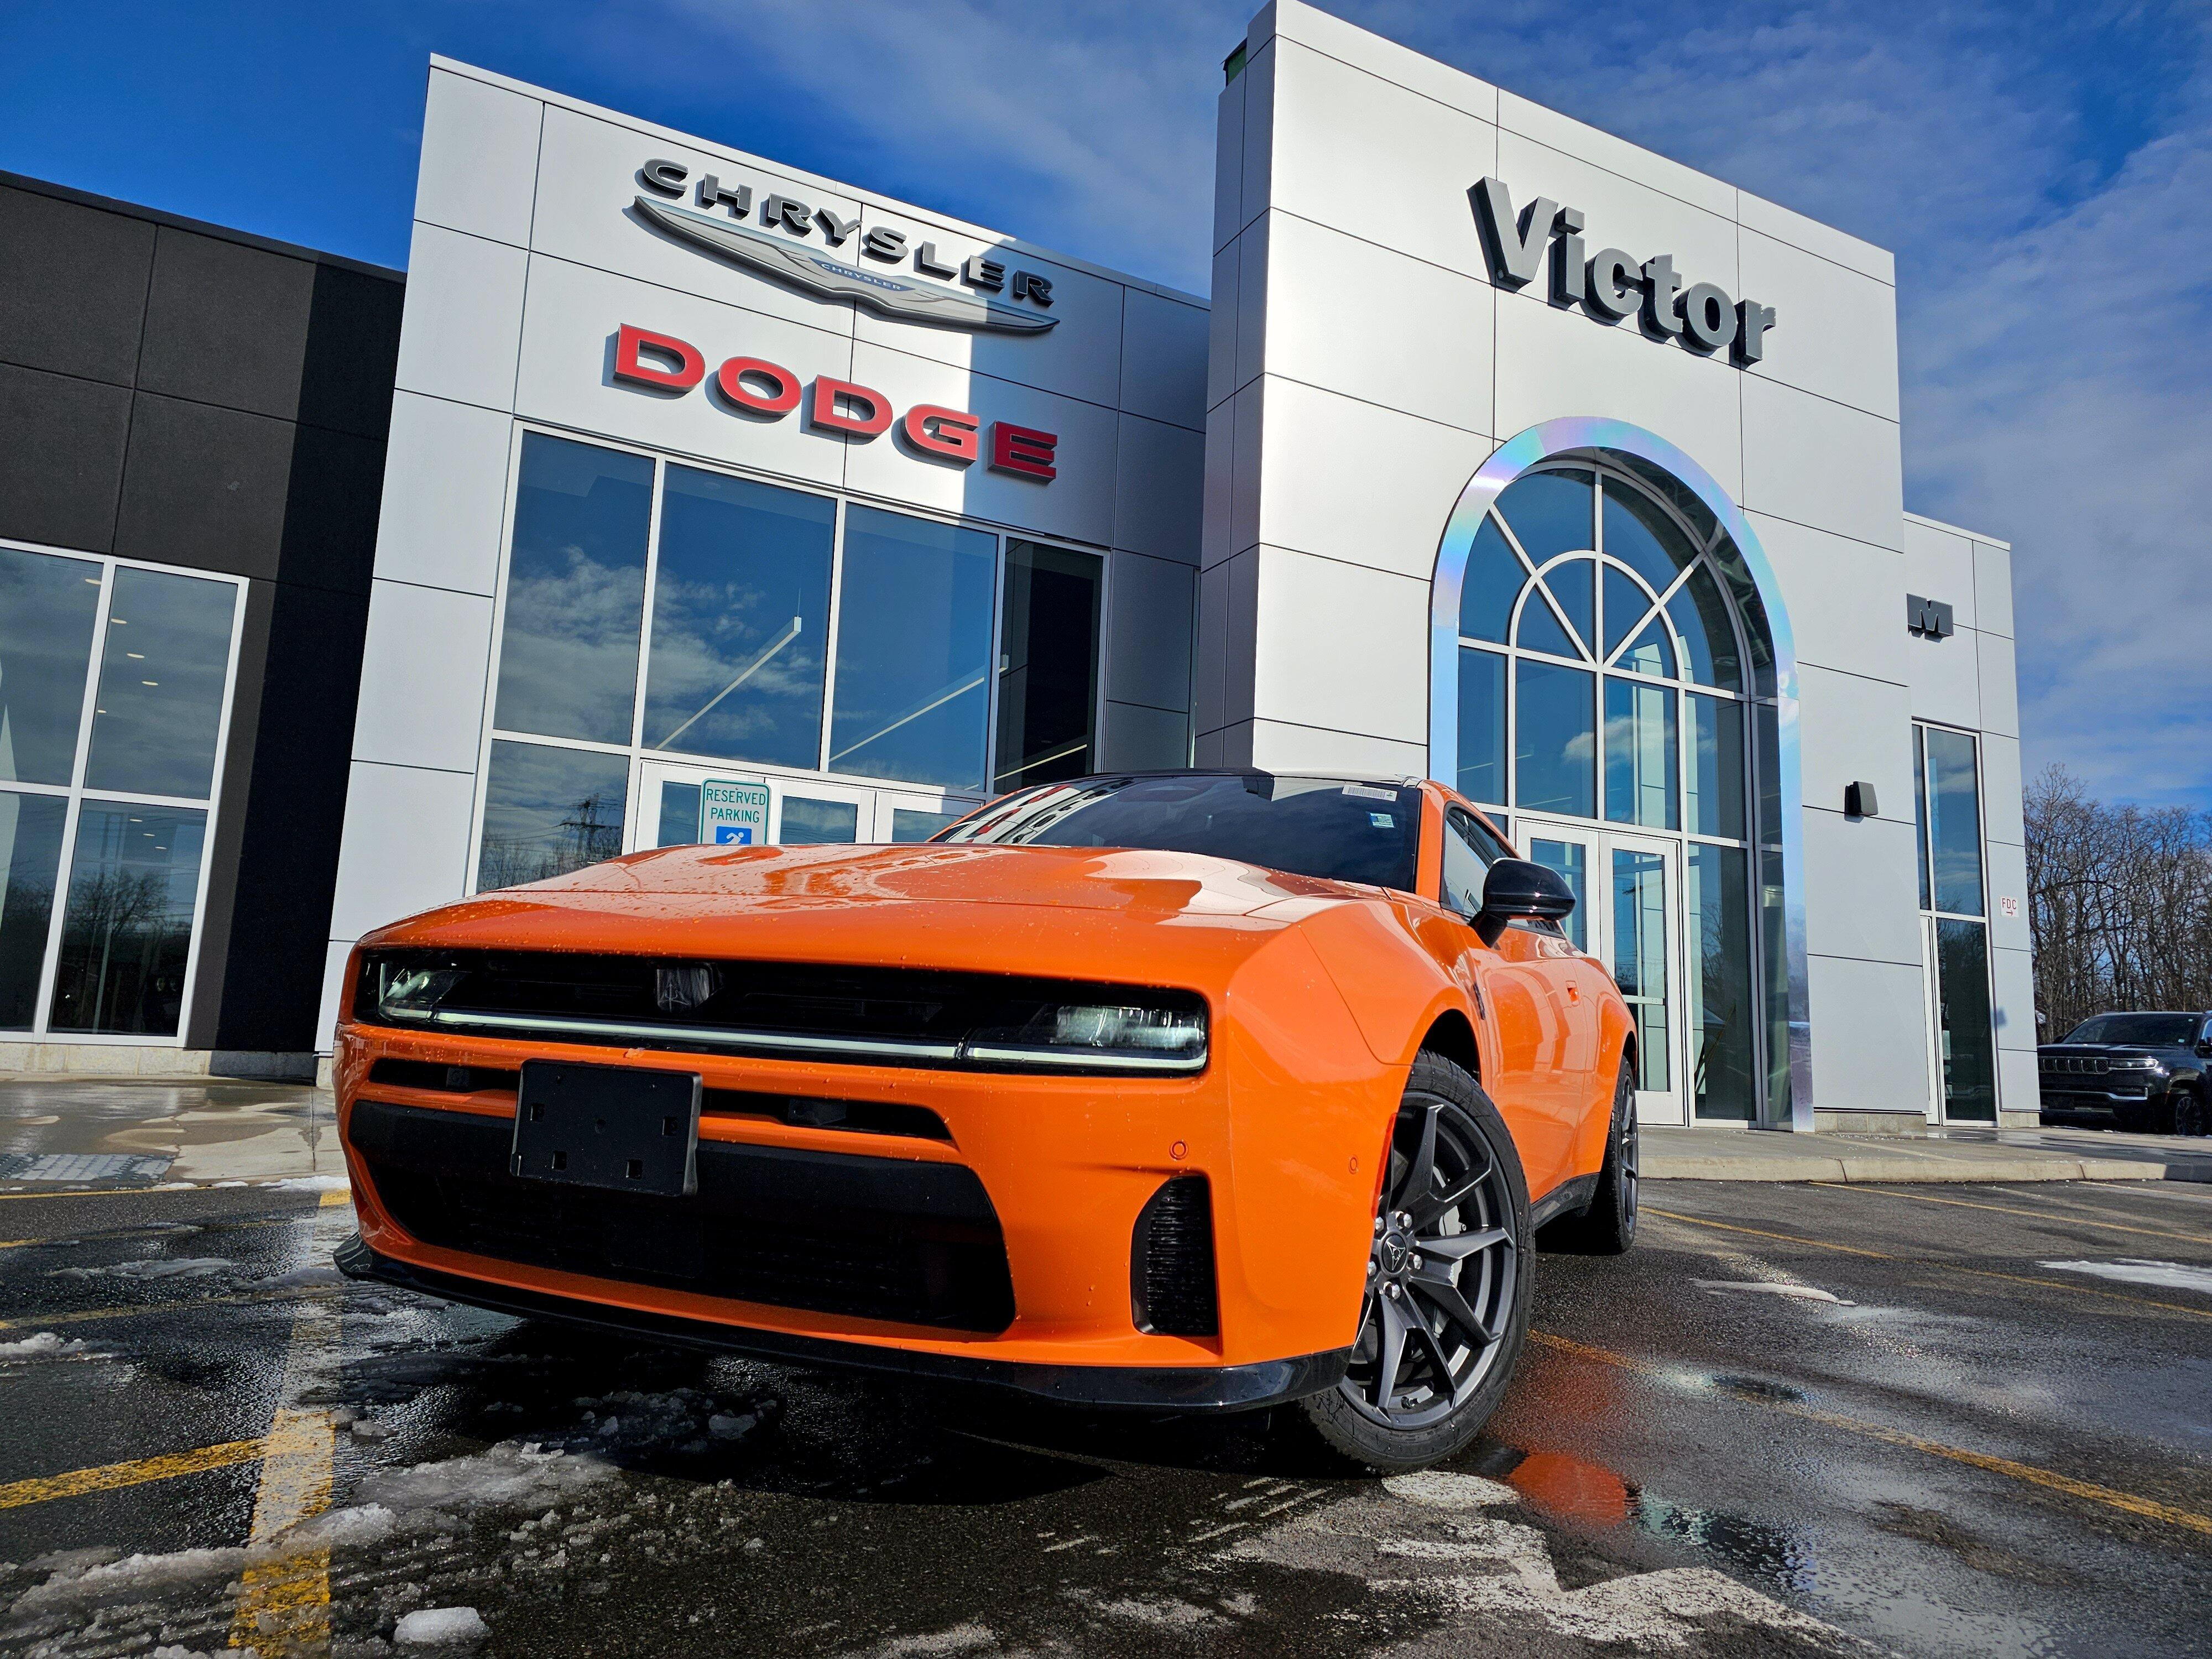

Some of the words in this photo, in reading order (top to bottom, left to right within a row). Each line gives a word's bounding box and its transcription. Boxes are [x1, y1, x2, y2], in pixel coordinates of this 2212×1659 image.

[643, 158, 1055, 306] CHRYSLER
[821, 264, 901, 290] CHRYSLER
[1467, 176, 1776, 364] Victor
[613, 323, 1057, 483] DODGE
[706, 789, 766, 805] RESERVED
[711, 807, 760, 823] PARKING
[2002, 898, 2016, 909] FDC
